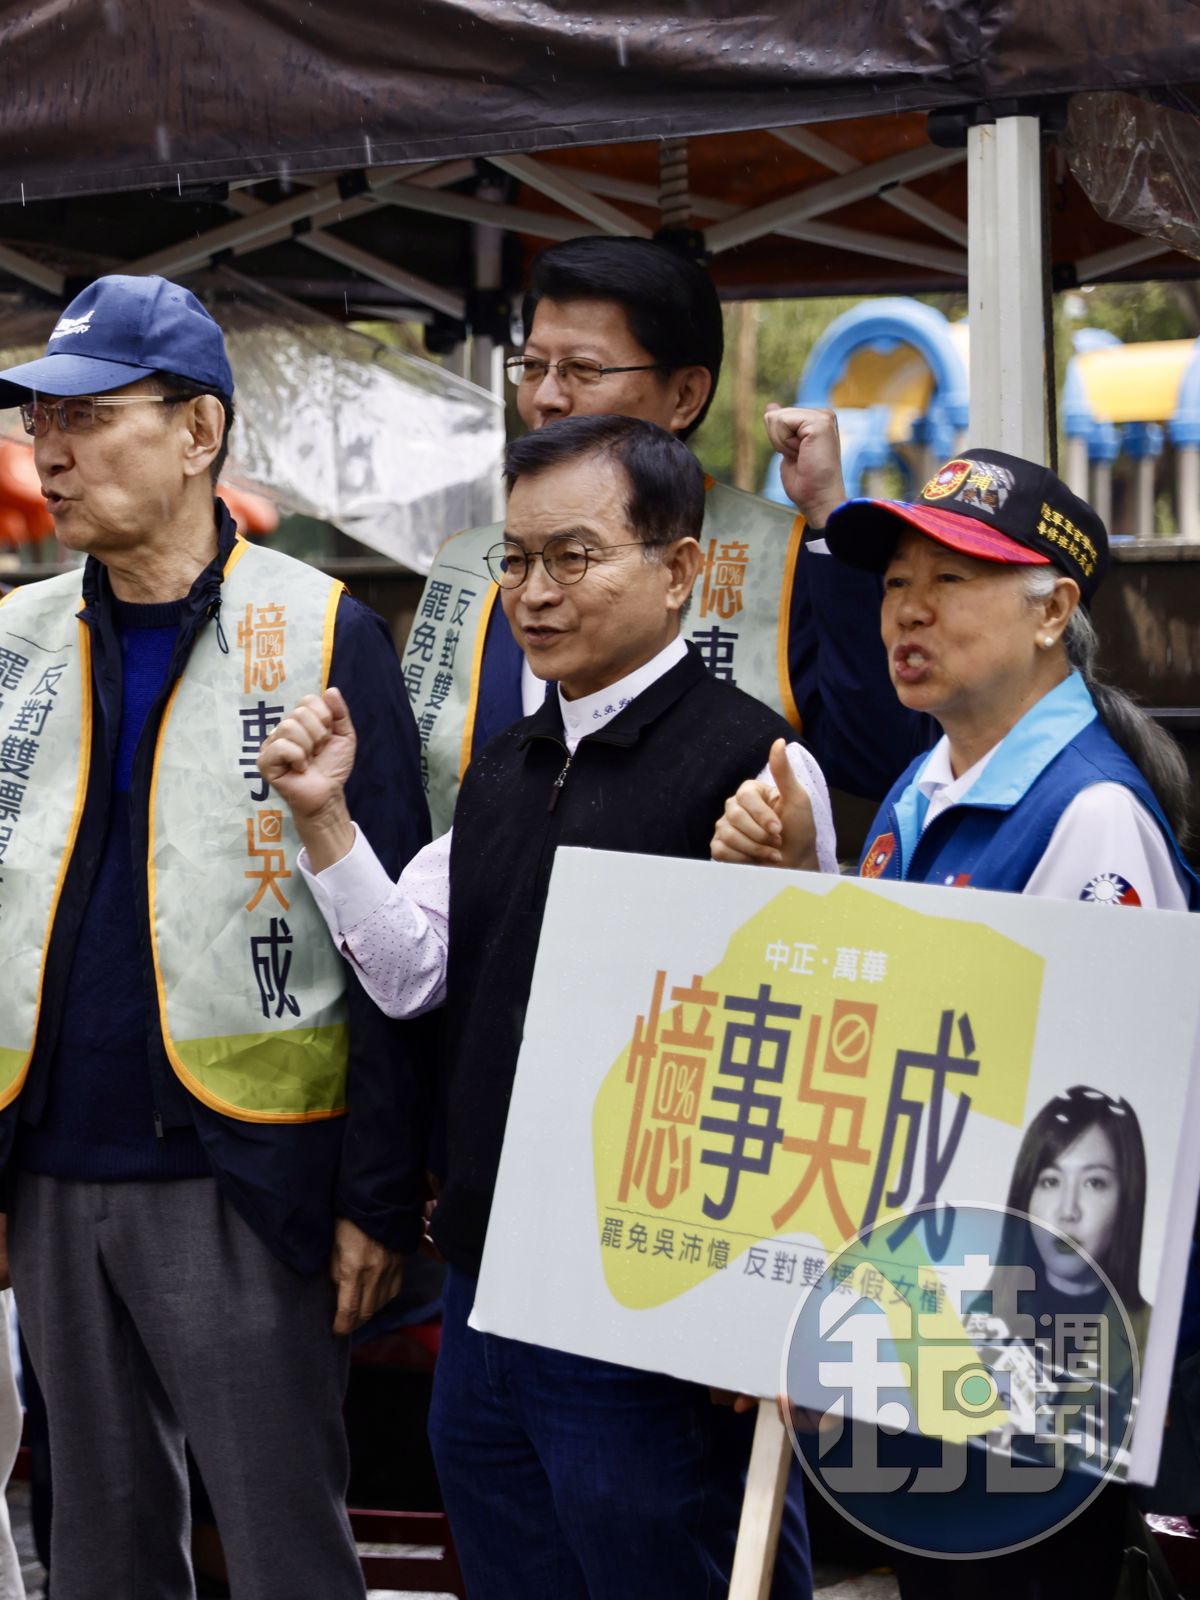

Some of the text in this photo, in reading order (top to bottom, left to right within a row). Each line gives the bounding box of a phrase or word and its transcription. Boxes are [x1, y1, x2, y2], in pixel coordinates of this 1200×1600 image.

[237, 602, 301, 1019] 憶事吳成
[617, 970, 980, 1262] 憶事吳成
[600, 1217, 947, 1315] 罷免吳沛憶 反對雙標假女權
